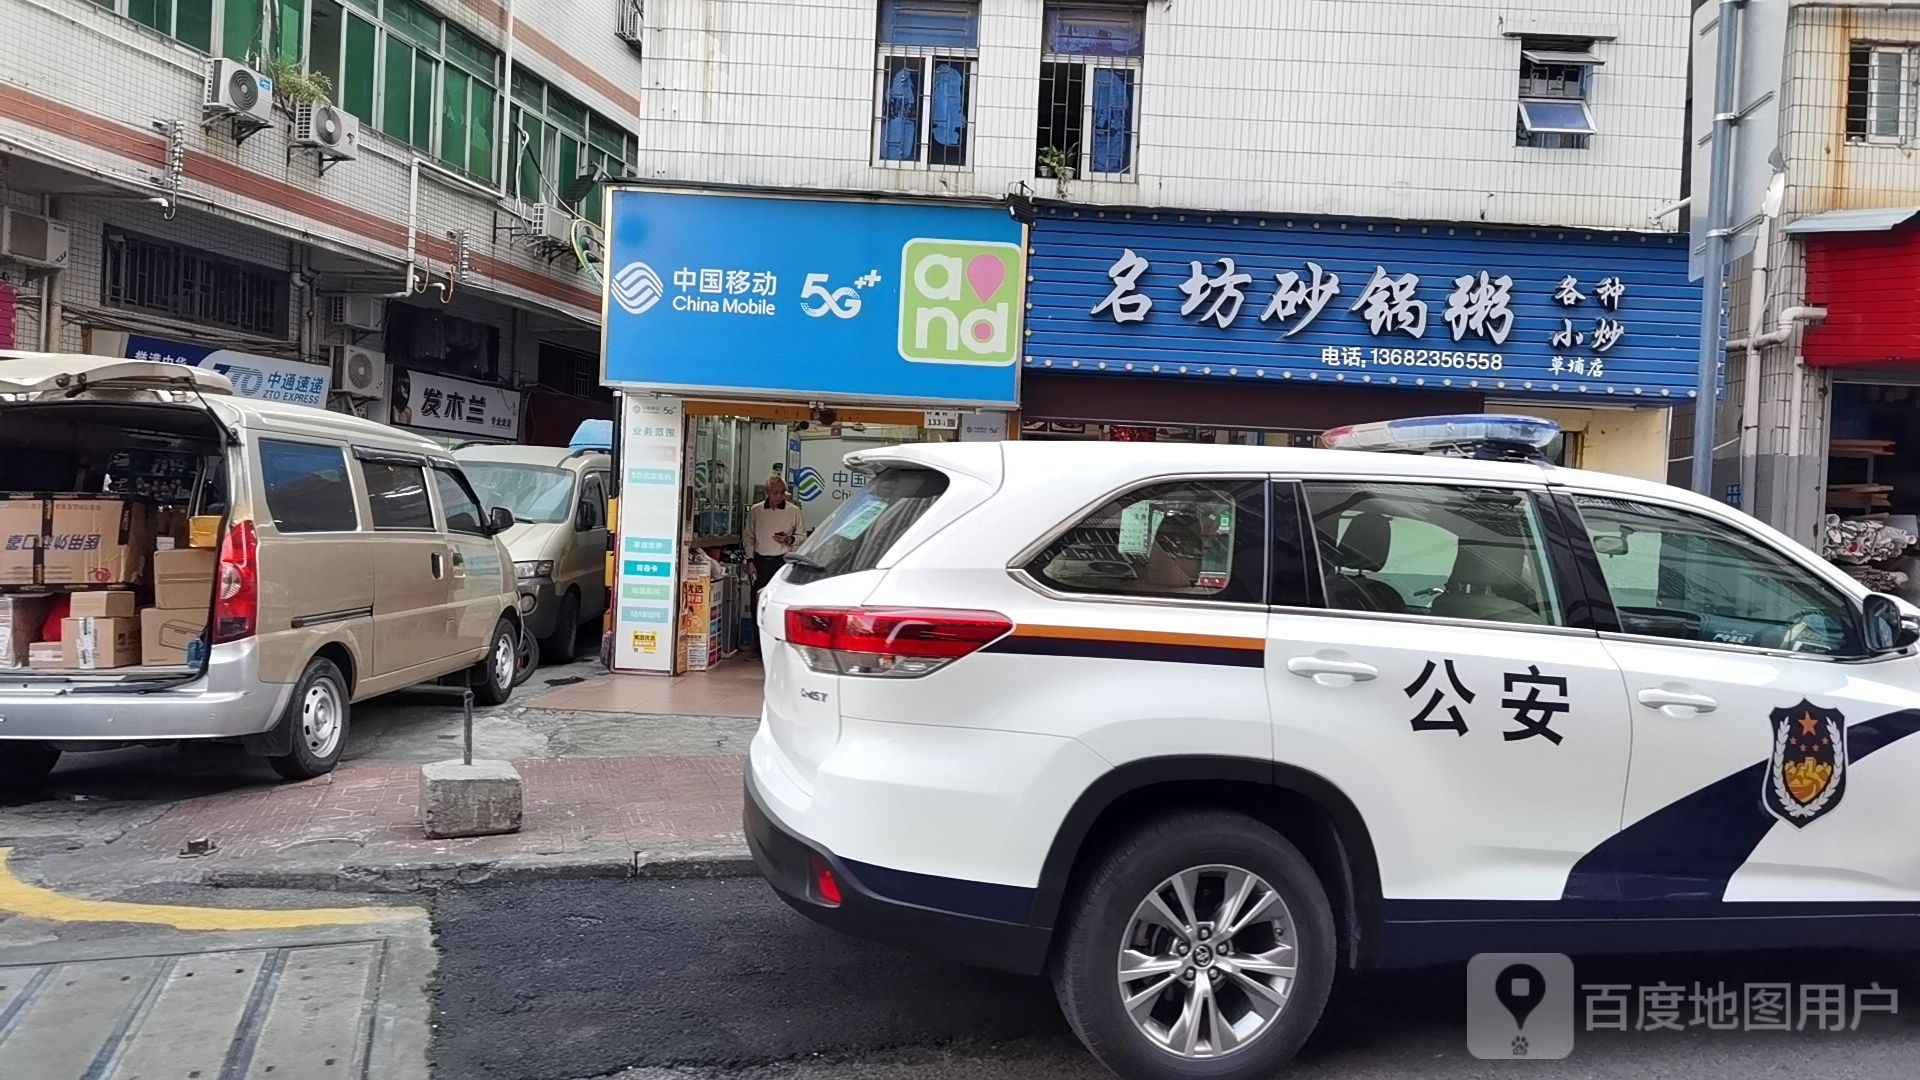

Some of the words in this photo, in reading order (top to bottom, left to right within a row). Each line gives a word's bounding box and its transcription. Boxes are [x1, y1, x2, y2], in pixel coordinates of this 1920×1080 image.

[673, 267, 777, 296] 中国移动
[1555, 275, 1625, 310] 各种
[672, 296, 719, 312] China
[722, 298, 775, 316] Mobile
[1090, 249, 1514, 345] 名坊砂锅粥
[1552, 318, 1624, 351] 小炒
[1548, 356, 1604, 378] 草埔店
[263, 389, 279, 399] ZTO
[283, 391, 319, 404] EXPRESS
[267, 371, 324, 394] 中通速递
[420, 388, 487, 425] 发木兰
[632, 427, 676, 438] 业务范围
[1404, 659, 1569, 746] 公安
